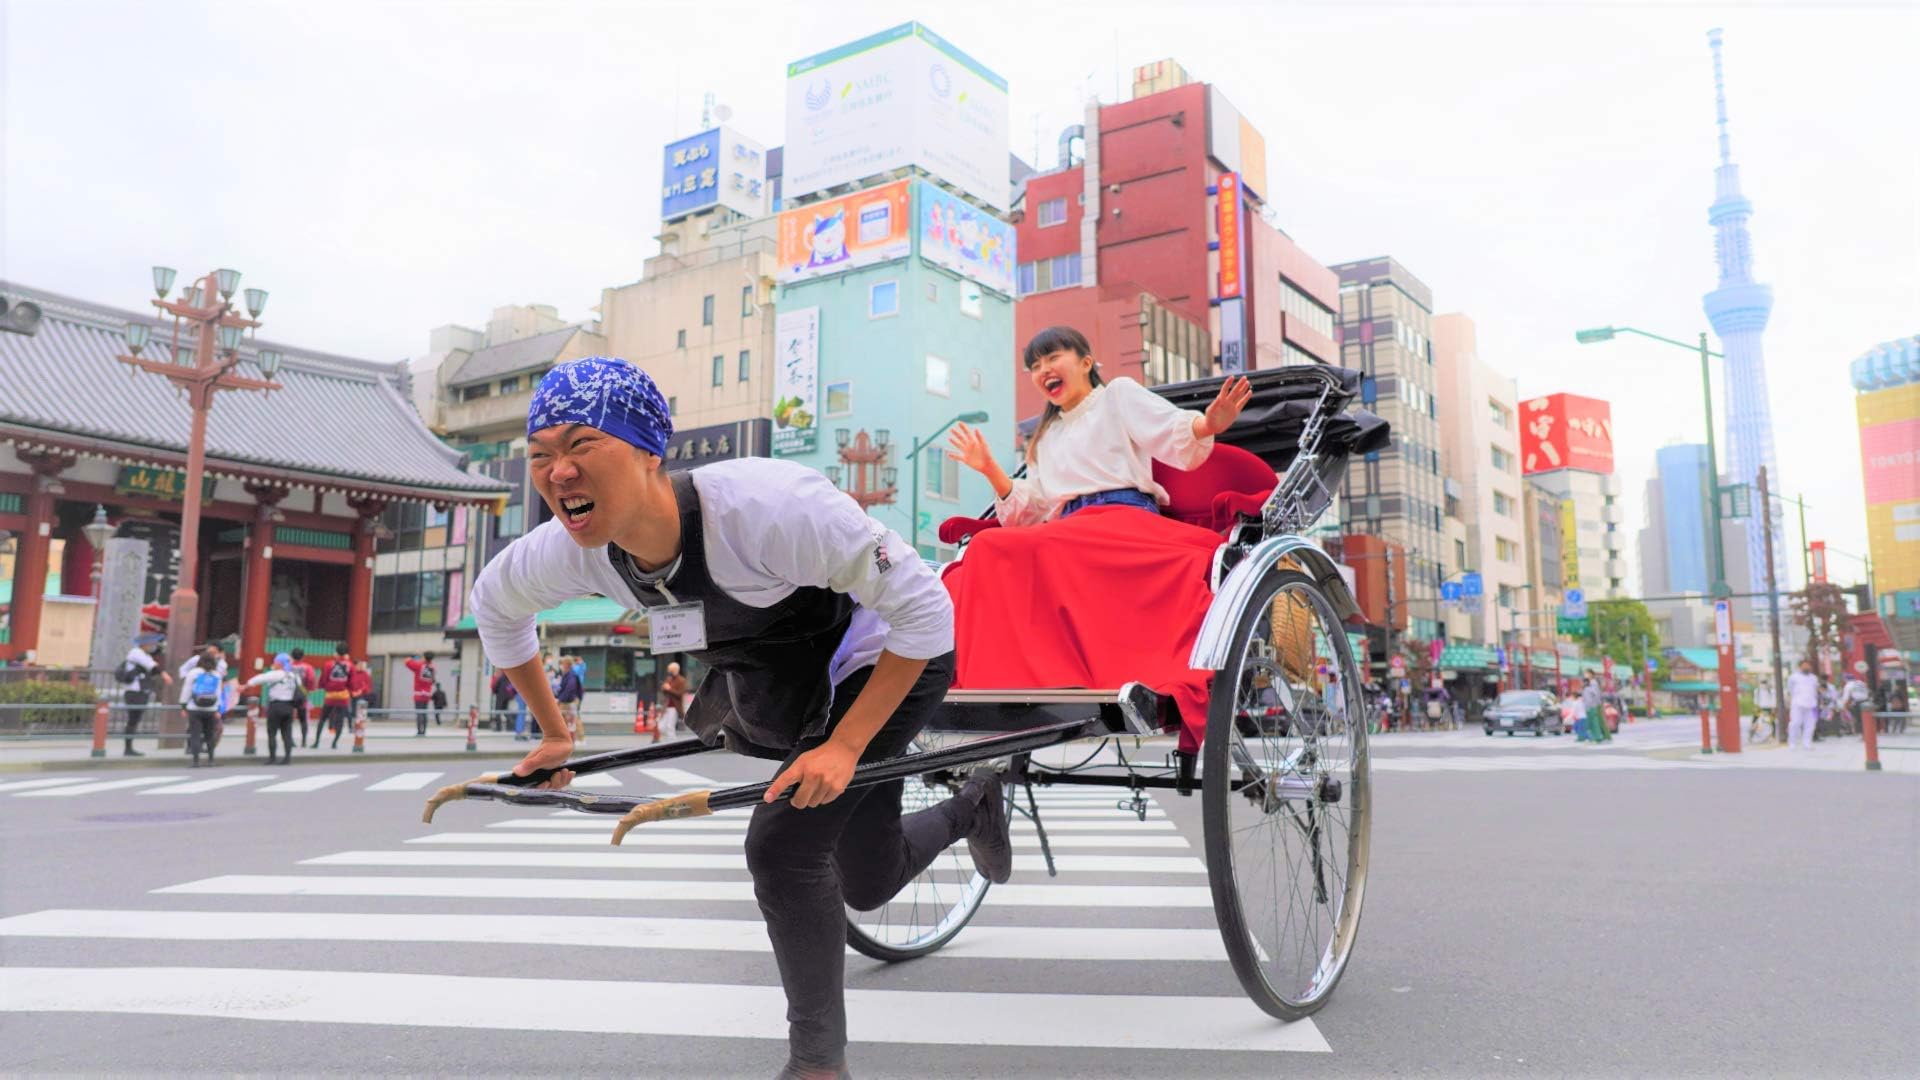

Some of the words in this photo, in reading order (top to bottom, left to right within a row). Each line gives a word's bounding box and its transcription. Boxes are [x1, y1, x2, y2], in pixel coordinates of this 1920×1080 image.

[1525, 397, 1560, 471] つぼ八
[1872, 450, 1912, 468] TOKYO
